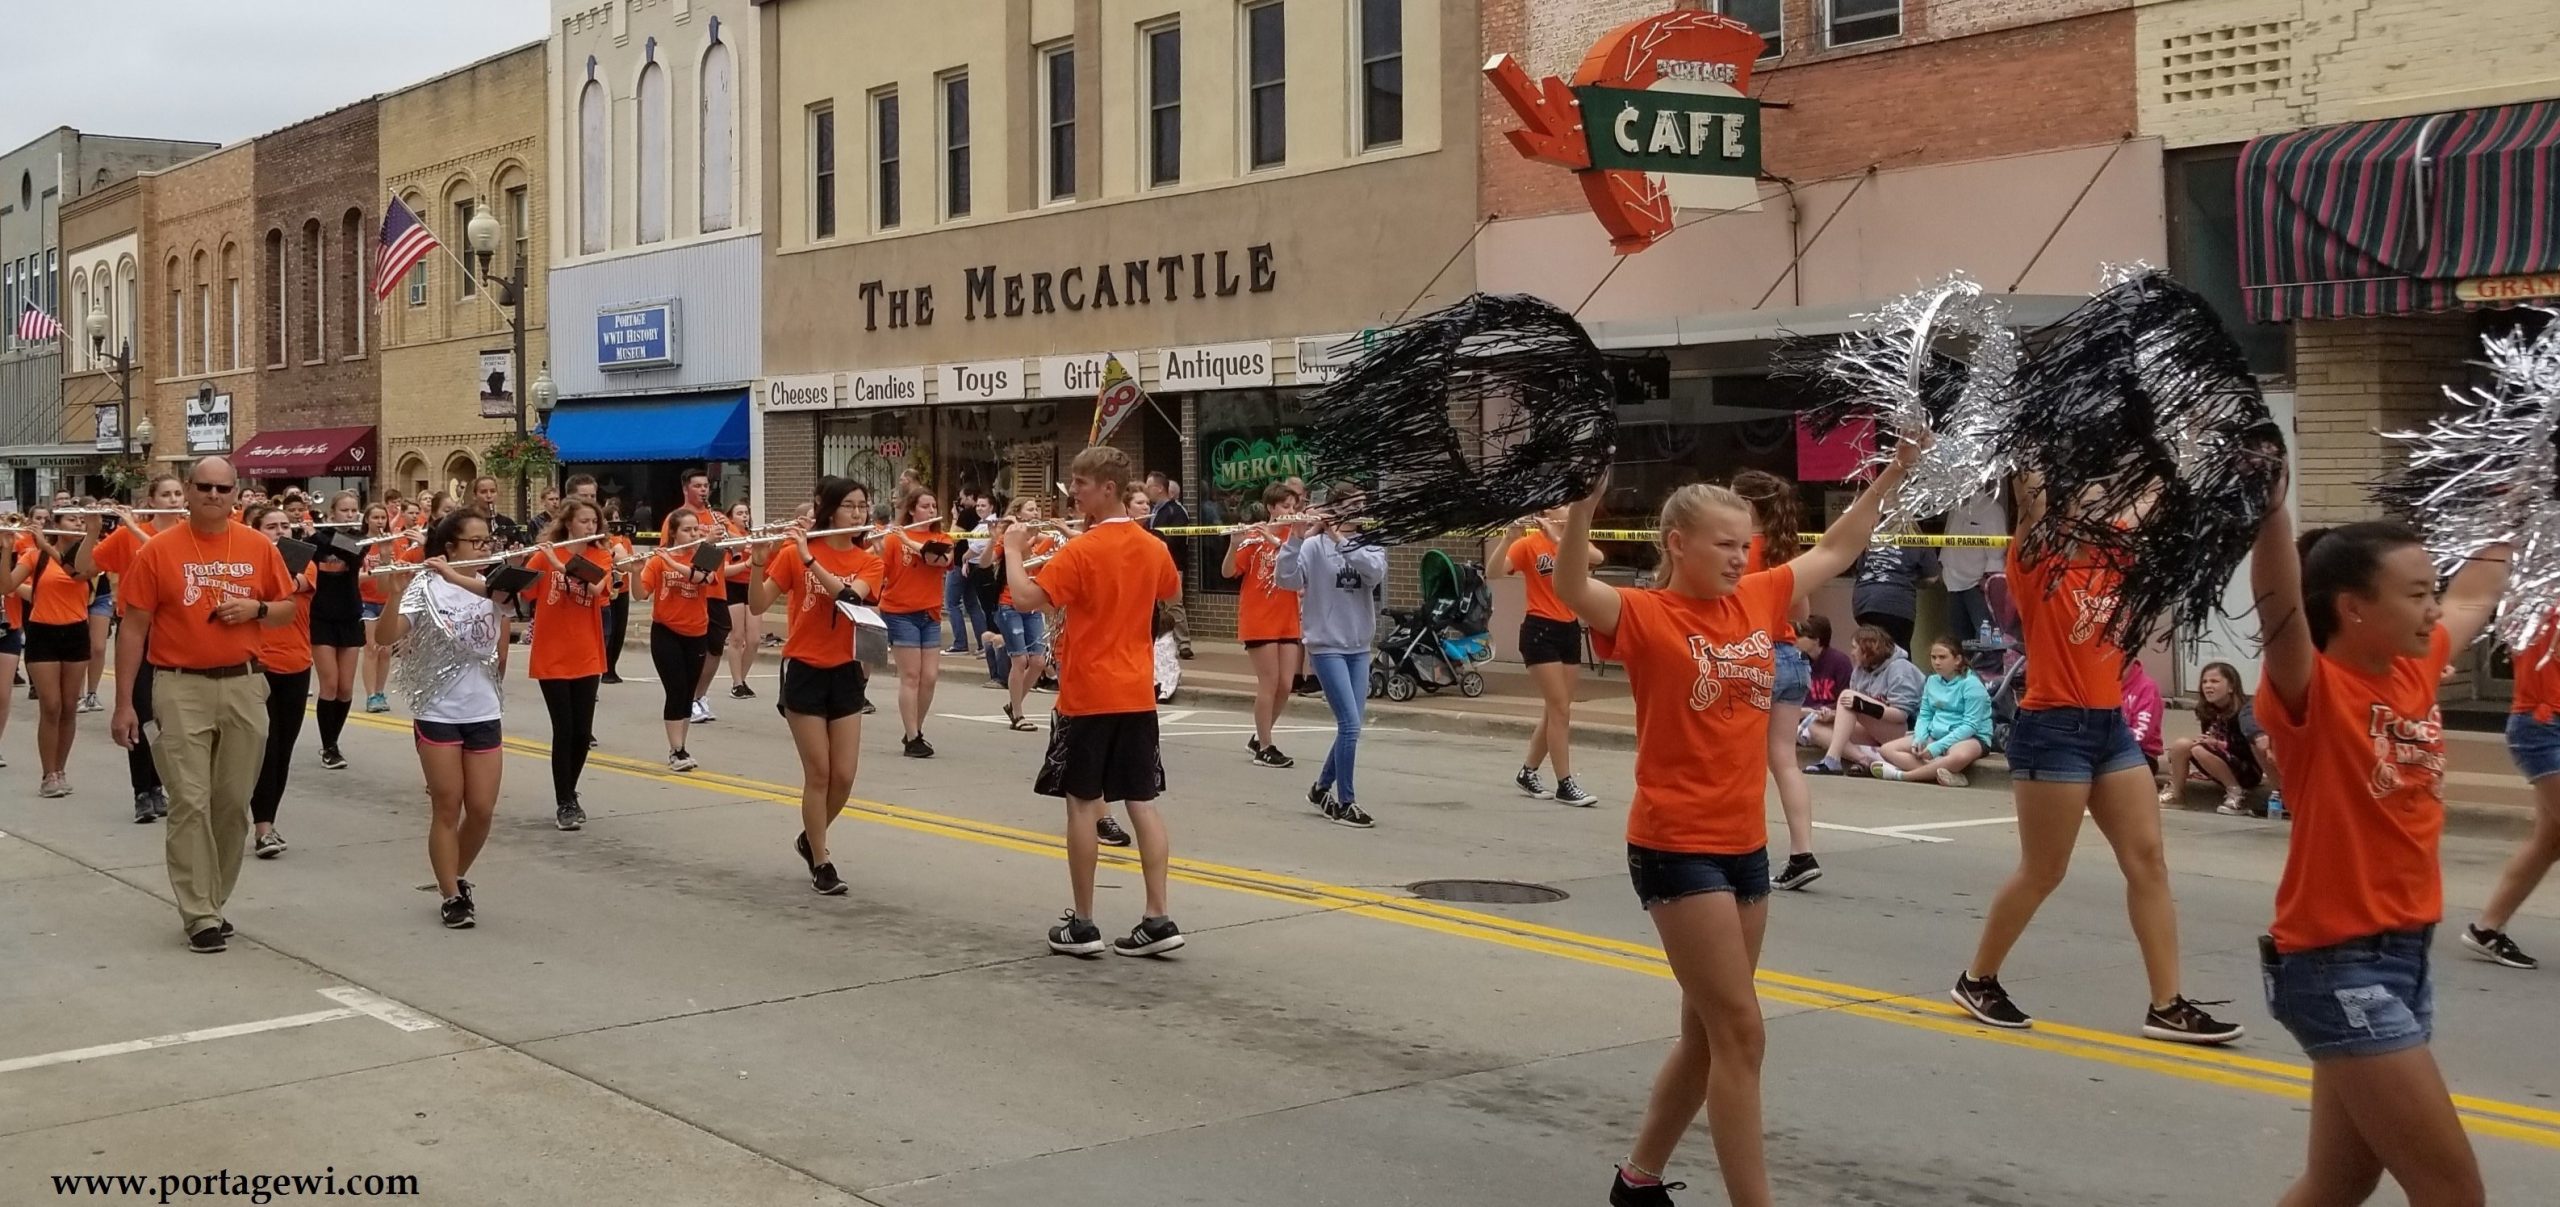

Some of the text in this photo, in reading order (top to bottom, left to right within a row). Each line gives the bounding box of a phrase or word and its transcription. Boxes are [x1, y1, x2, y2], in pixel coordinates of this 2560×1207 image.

[1614, 104, 1746, 158] CAFE
[858, 242, 1277, 331] THE MERCANTILE
[614, 313, 647, 329] PORTAGE
[602, 328, 659, 346] WWII HISTORY
[616, 345, 646, 361] MUSEUM
[1064, 360, 1101, 390] Gift
[1166, 350, 1264, 385] Antiques
[854, 374, 915, 401] Candies
[952, 366, 1008, 397] Toys
[771, 381, 828, 406] Cheeses
[879, 440, 905, 459] OPEN
[334, 464, 372, 472] JEWELRY
[1590, 531, 1615, 540] PARKING
[1627, 532, 1636, 540] NO
[1898, 536, 1930, 545] PARKING
[1945, 537, 1991, 547] NO PARKING
[183, 561, 254, 578] Portage
[197, 576, 252, 597] Marching
